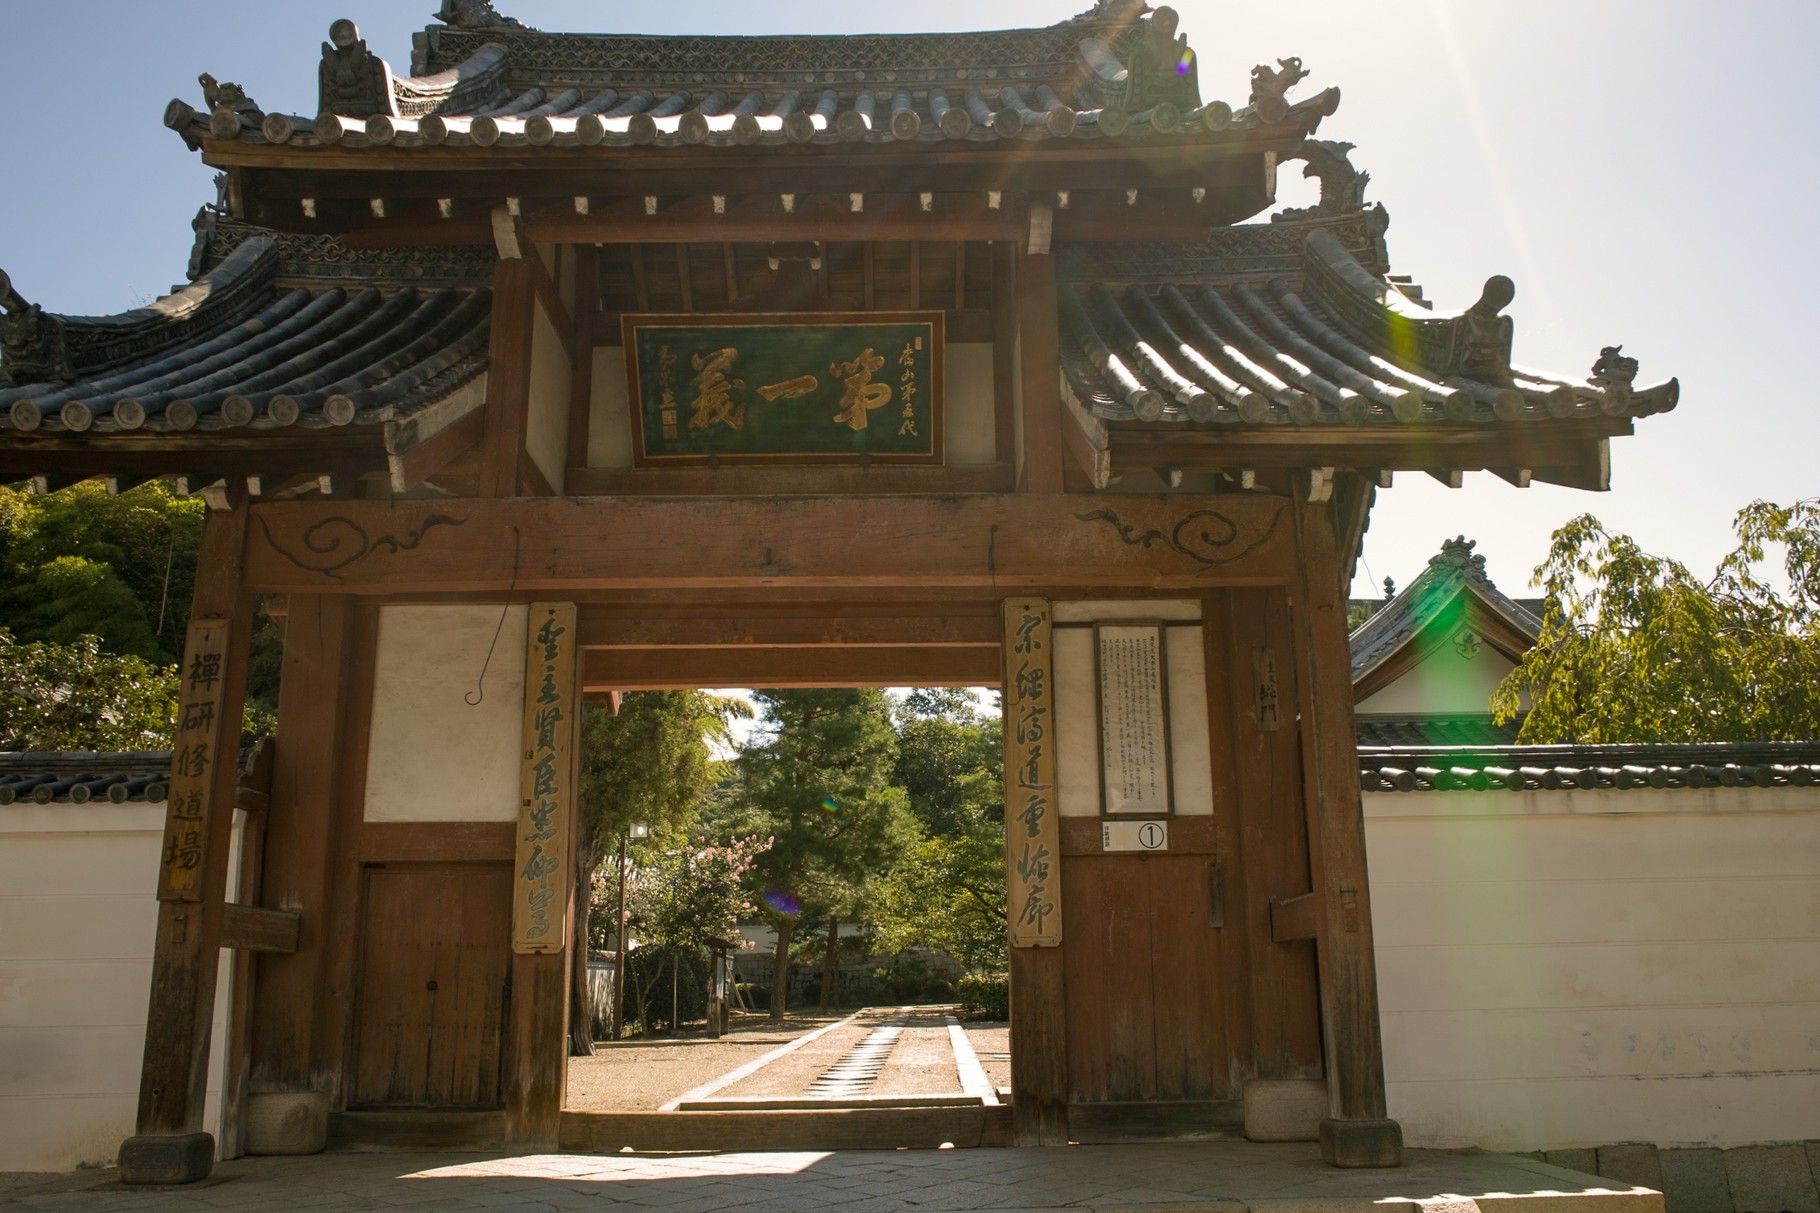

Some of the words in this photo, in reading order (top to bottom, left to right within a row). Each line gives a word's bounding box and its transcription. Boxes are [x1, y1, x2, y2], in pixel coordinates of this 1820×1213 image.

[166, 652, 222, 871] 禪研修道場
